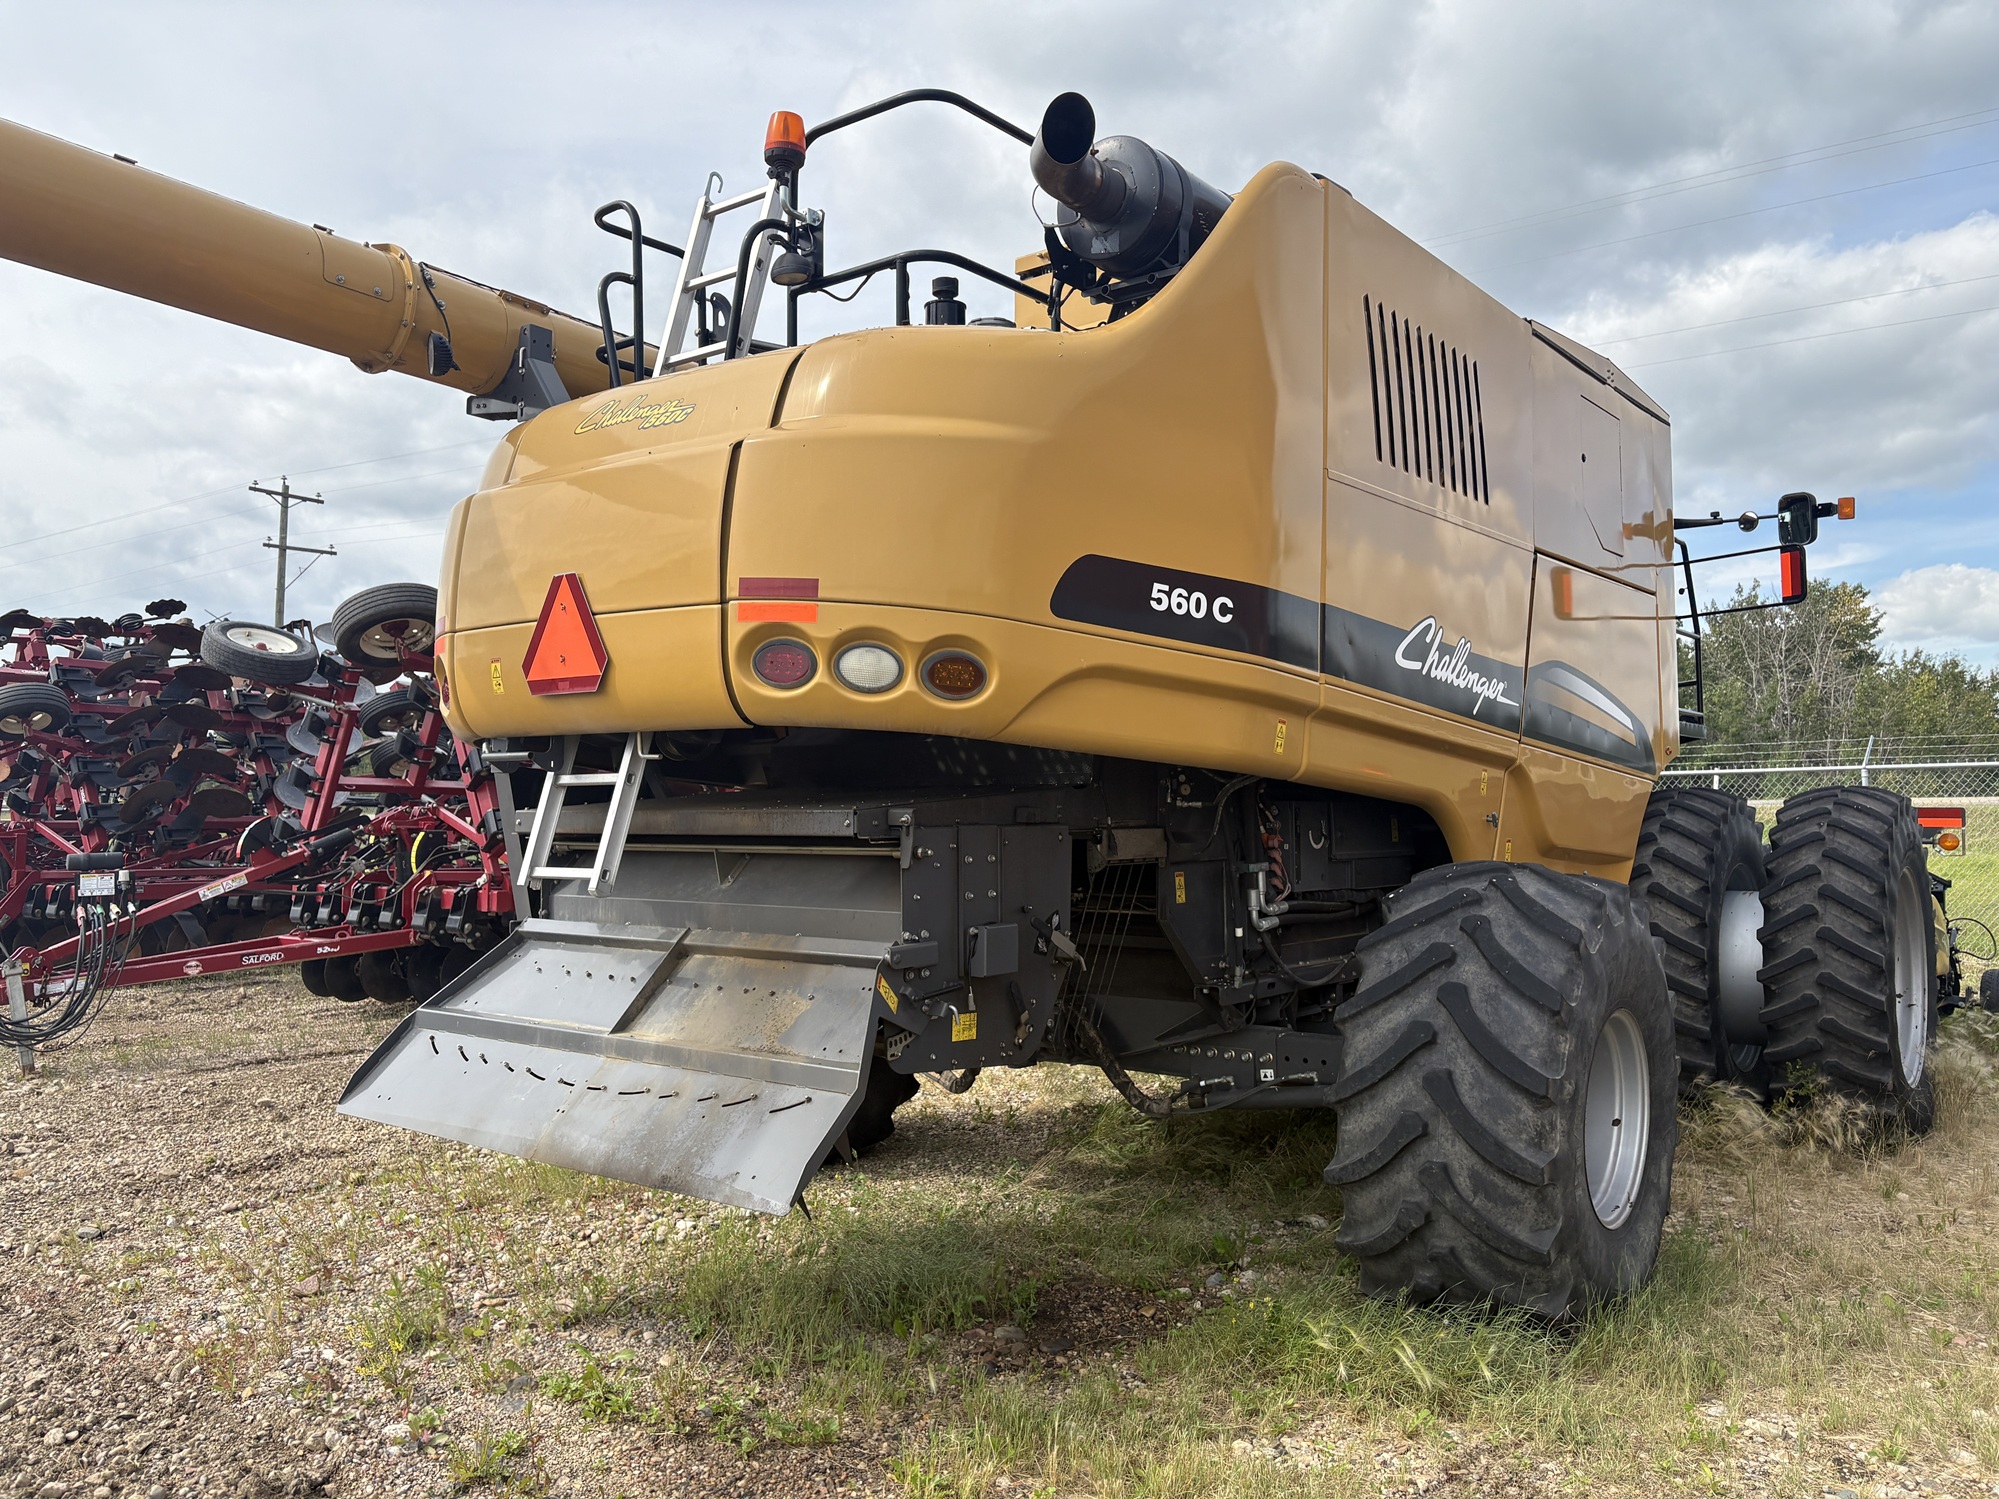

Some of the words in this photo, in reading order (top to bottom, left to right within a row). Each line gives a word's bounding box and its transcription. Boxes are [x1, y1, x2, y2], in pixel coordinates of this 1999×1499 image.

[574, 394, 696, 435] Challenger
[643, 407, 694, 430] 560C
[1149, 582, 1208, 619] 560
[1212, 596, 1234, 624] C
[1394, 616, 1520, 715] Challenger
[241, 951, 285, 965] SALFORD
